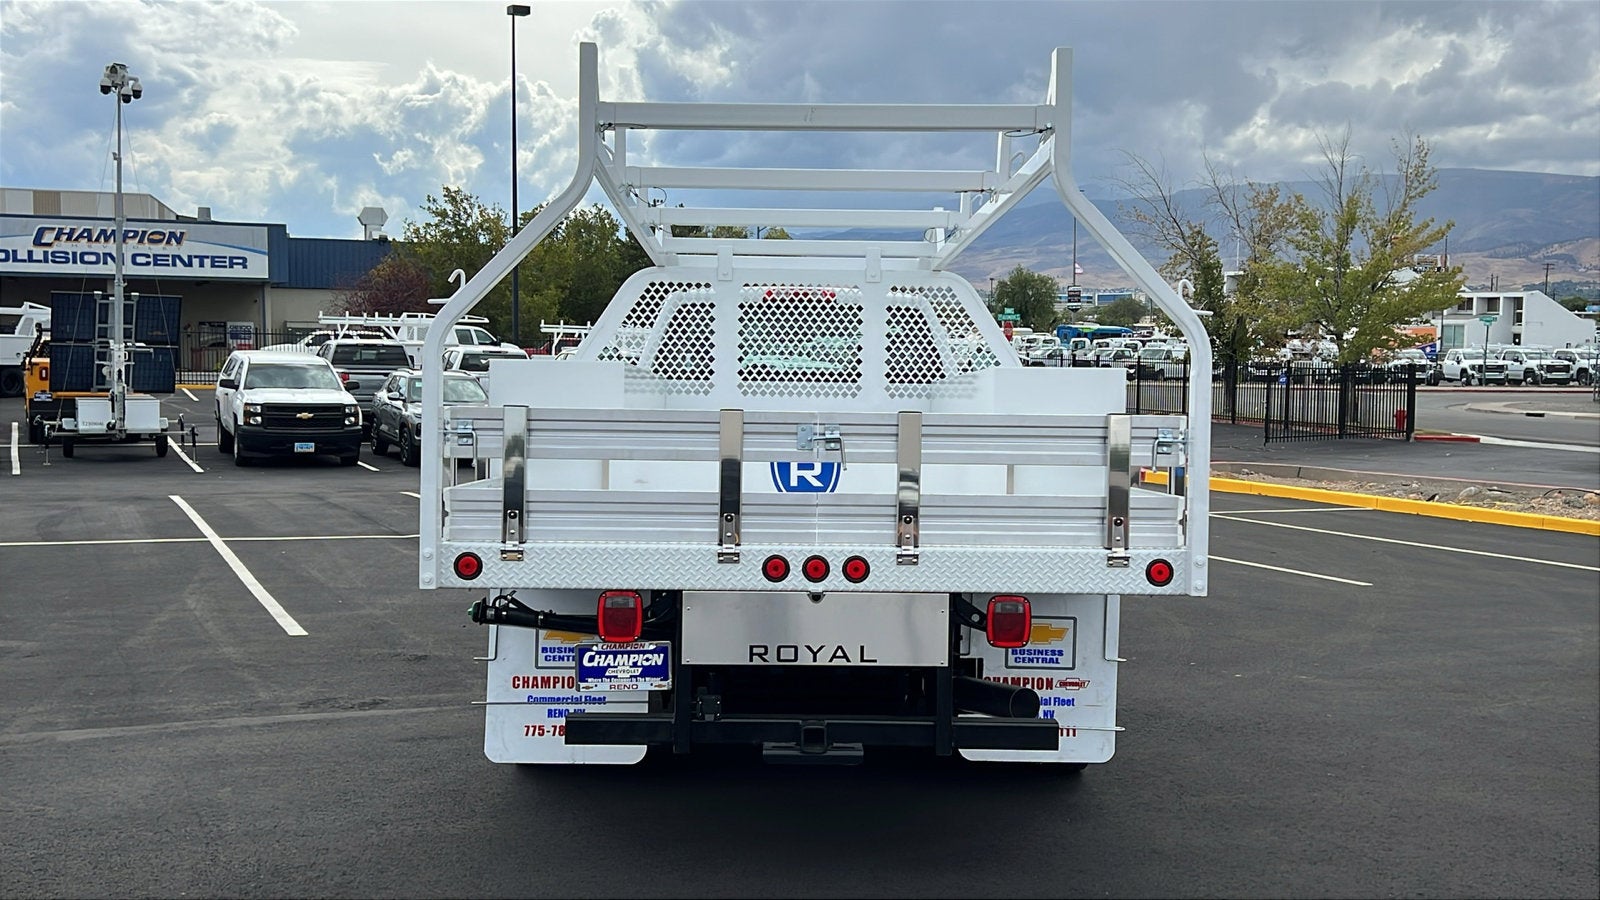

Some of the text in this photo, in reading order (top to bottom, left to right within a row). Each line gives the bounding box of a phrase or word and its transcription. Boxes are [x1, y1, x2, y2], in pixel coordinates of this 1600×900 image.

[33, 226, 186, 247] CHAMPION
[131, 253, 248, 269] CENTER
[789, 461, 825, 487] R
[582, 651, 664, 667] CHAMPION
[748, 644, 878, 663] ROYAL
[1011, 648, 1064, 656] BUSINESS
[1014, 656, 1061, 664] CENTRAL
[1053, 696, 1075, 706] Fleet
[1043, 709, 1055, 719] NV
